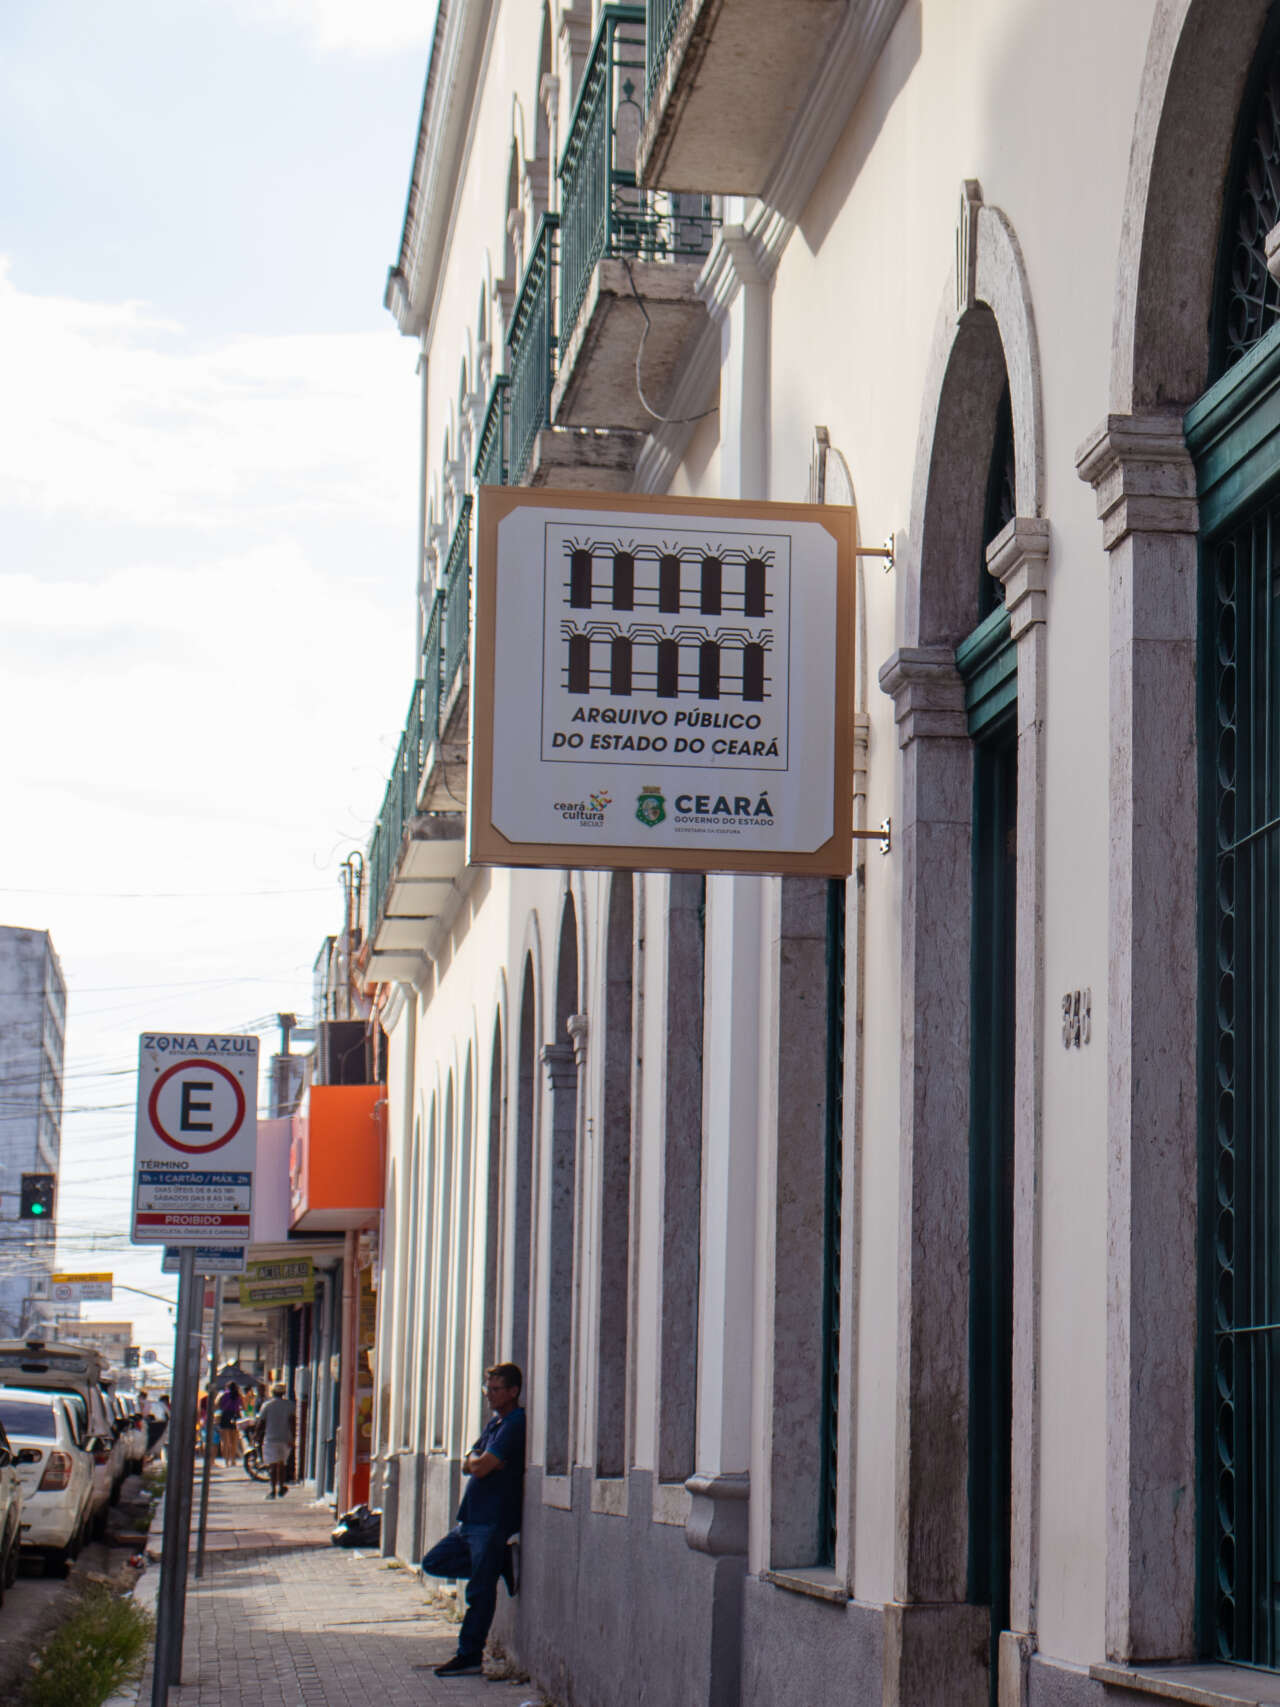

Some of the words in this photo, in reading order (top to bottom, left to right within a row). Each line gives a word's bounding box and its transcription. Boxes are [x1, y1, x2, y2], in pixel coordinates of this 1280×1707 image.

[571, 706, 668, 727] ARQUIVO
[673, 708, 762, 731] PÚBLICO
[551, 732, 584, 749] DO
[590, 734, 668, 753] ESTADO
[673, 738, 705, 754] DO
[711, 737, 780, 758] CEARÁ
[553, 799, 586, 812] ceará
[674, 790, 774, 817] CEARÁ
[561, 809, 605, 821] cultura
[674, 815, 720, 825] GOVERNO
[721, 817, 736, 826] DO
[738, 818, 775, 827] ESTADO
[143, 1036, 199, 1053] ZONA
[205, 1038, 257, 1053] AZUL
[180, 1081, 214, 1132] E
[140, 1160, 190, 1170] TÉRMINO
[164, 1173, 204, 1184] CARTÃO
[164, 1215, 222, 1225] PROIBIDO
